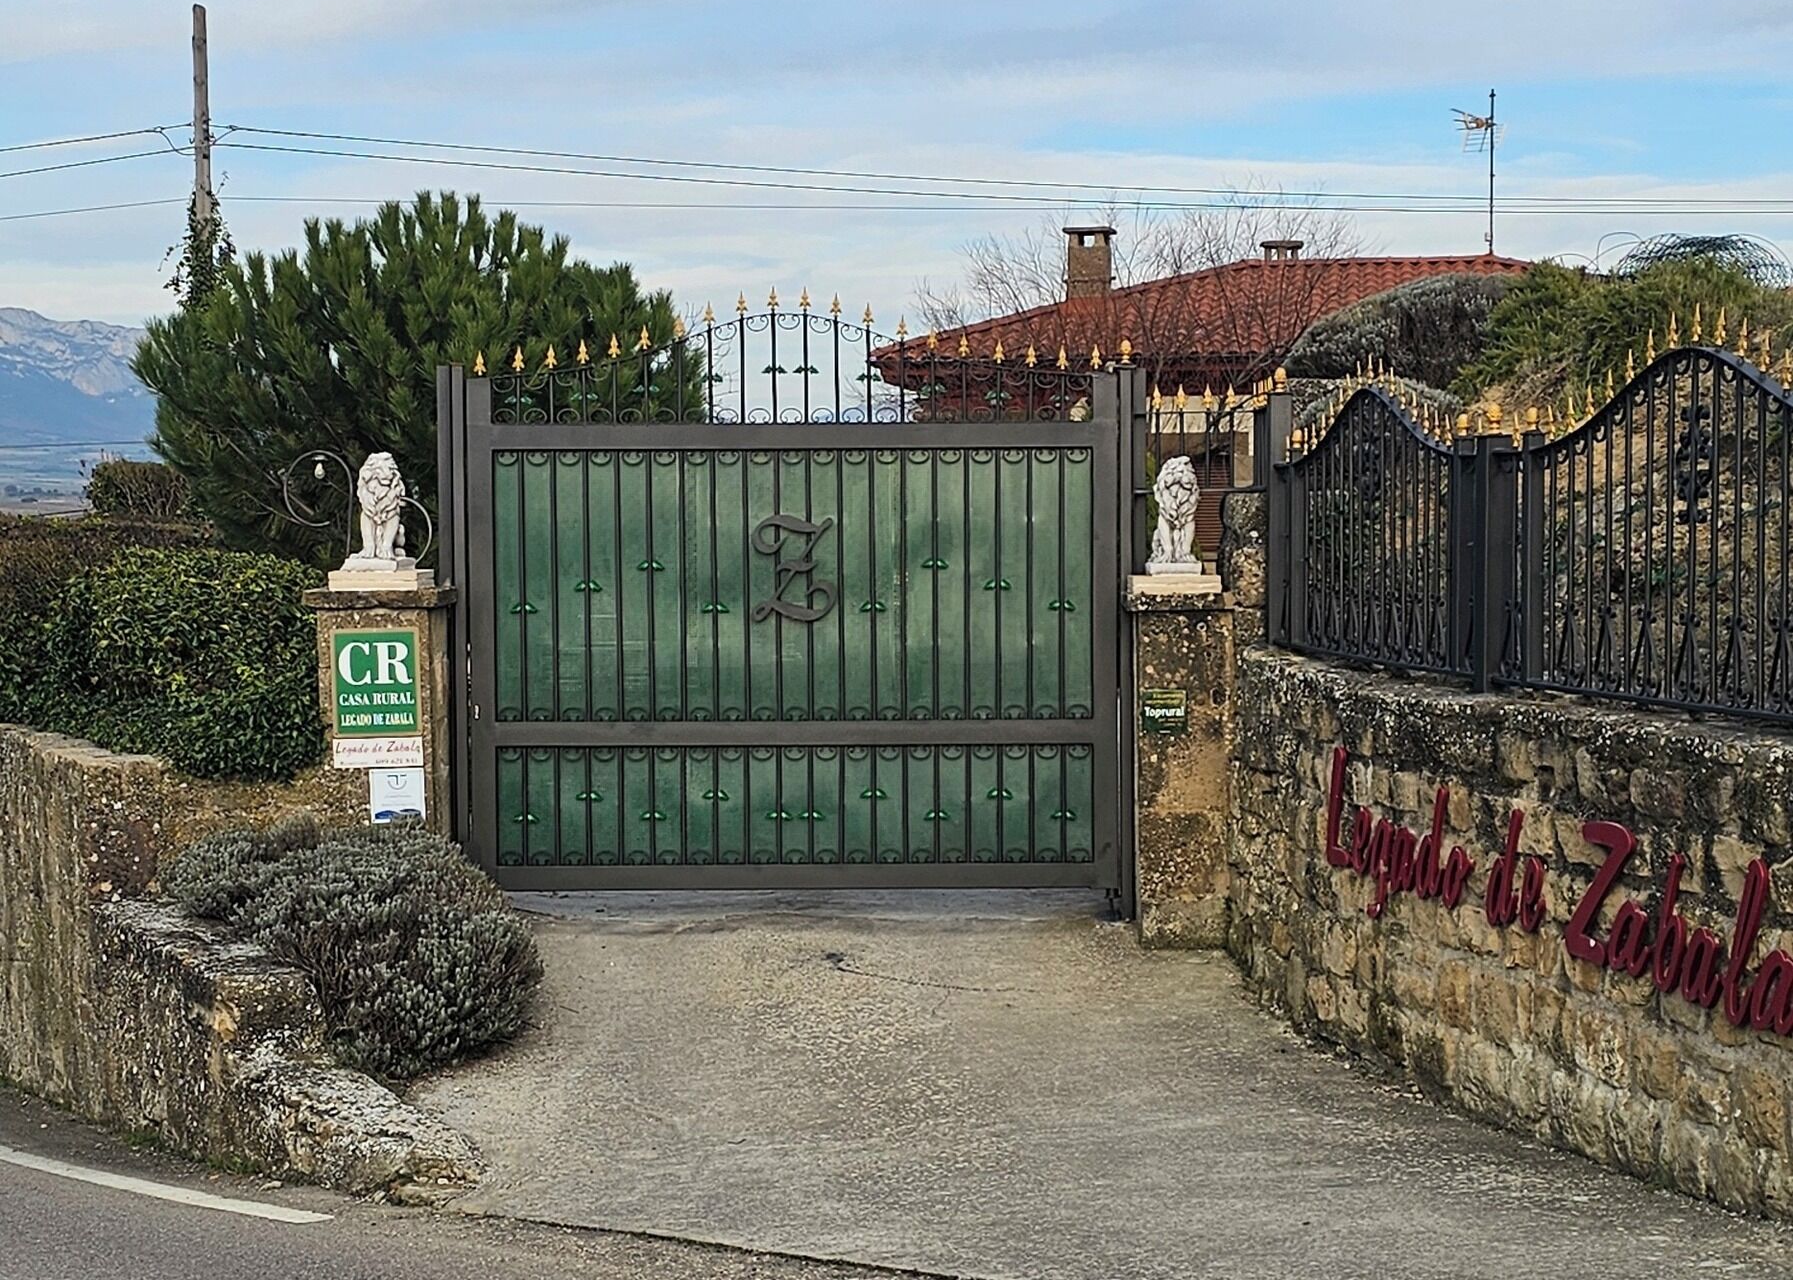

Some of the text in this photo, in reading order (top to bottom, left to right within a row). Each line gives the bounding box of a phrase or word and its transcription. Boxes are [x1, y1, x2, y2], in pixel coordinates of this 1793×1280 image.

[338, 642, 413, 685] CR
[339, 691, 415, 706] CASA RURAL
[341, 712, 414, 726] LEGADO DE ZABALA
[1144, 706, 1185, 718] Toprural
[336, 742, 369, 757] Legado
[372, 743, 382, 753] de
[1327, 746, 1793, 1035] Legado de Zabala
